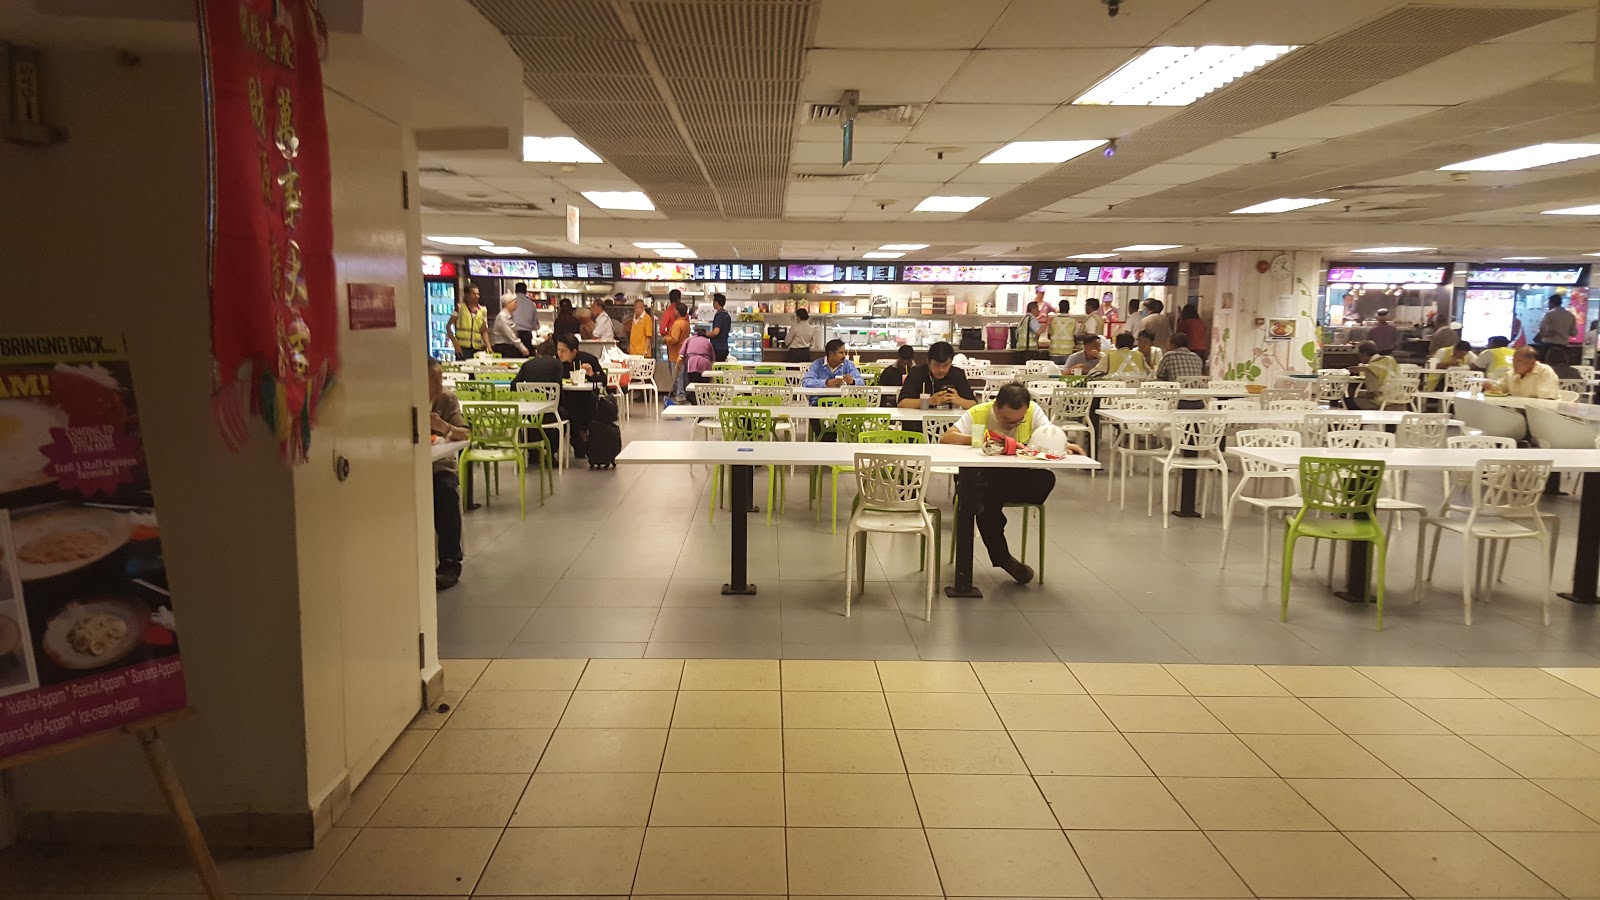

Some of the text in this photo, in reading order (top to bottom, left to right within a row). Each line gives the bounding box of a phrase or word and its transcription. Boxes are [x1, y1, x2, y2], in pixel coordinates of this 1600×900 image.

[6, 660, 182, 715] Nutella Appam Peanut Appam Banana Appam
[24, 719, 44, 741] Split
[44, 715, 73, 736] Appam
[115, 697, 141, 716] Appam
